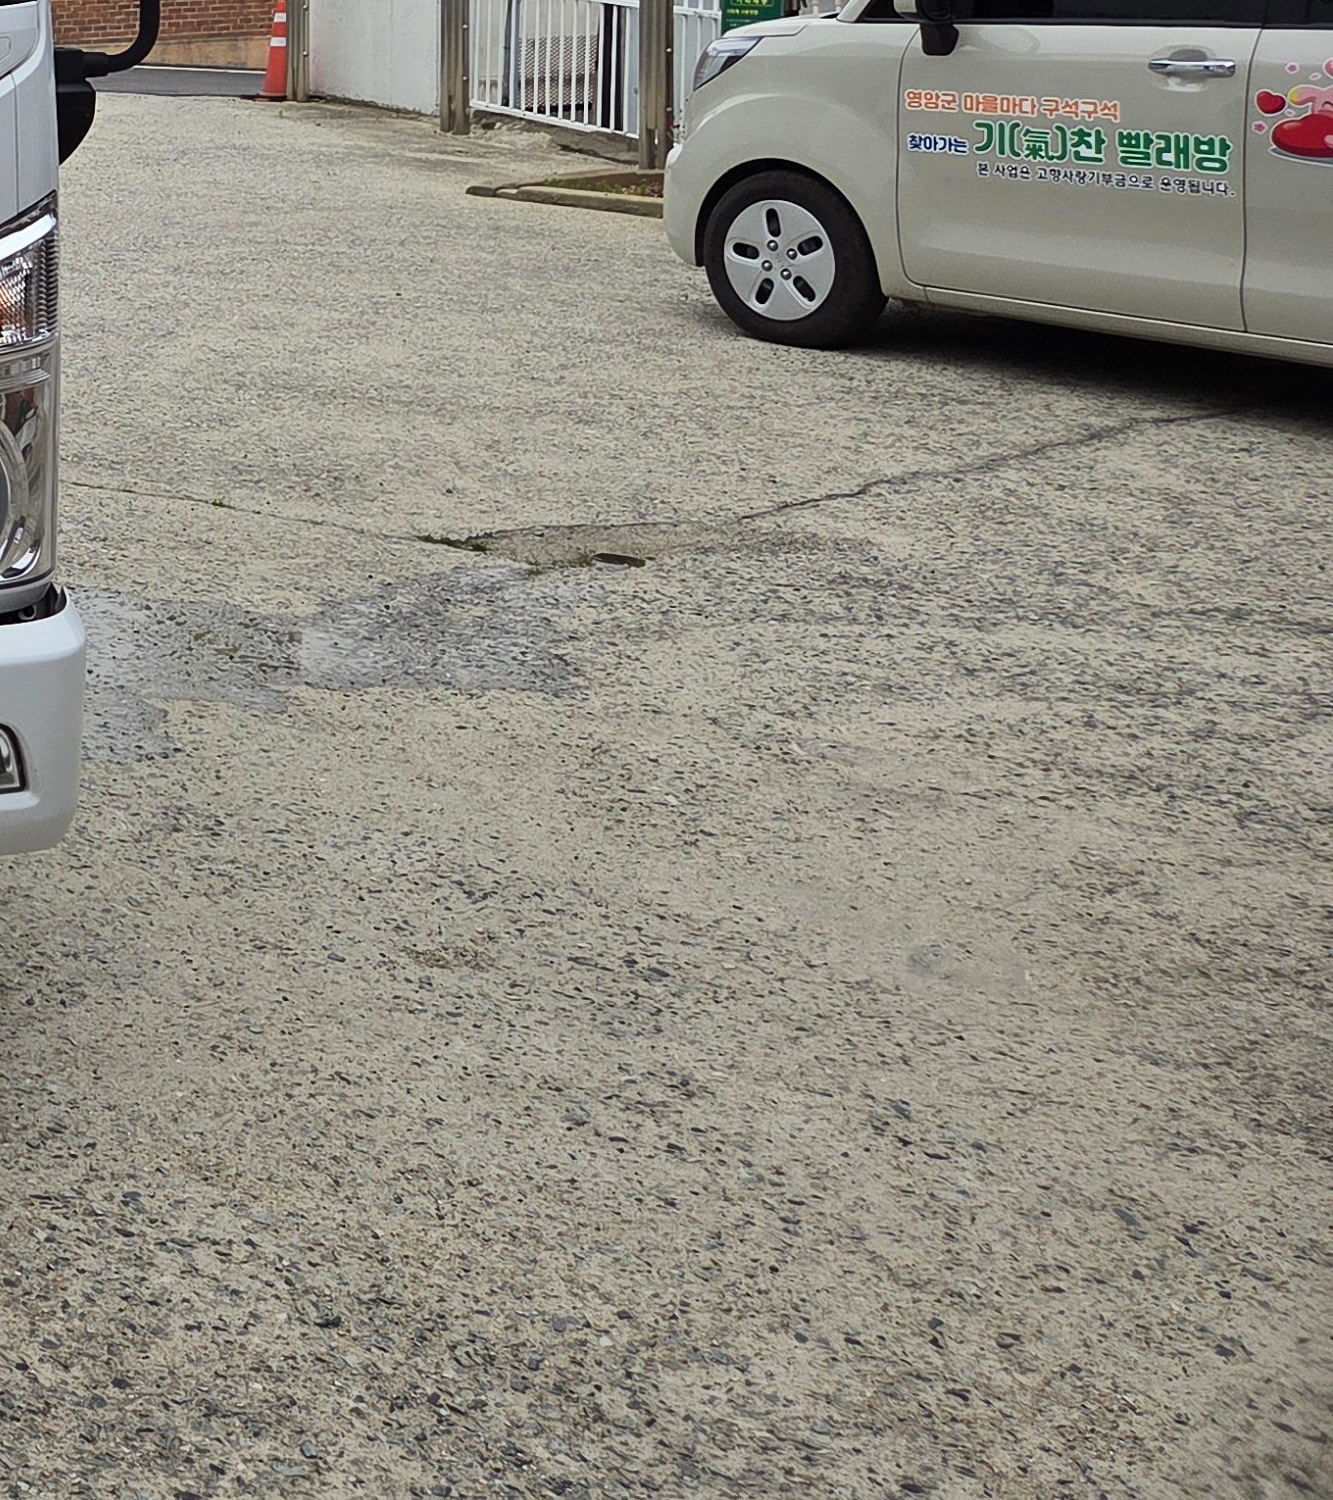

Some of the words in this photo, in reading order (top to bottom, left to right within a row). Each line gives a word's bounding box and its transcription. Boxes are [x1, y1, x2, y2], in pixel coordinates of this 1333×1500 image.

[905, 90, 958, 111] 영암군
[962, 94, 1037, 116] 마을마다
[1041, 98, 1120, 122] 구석구석
[908, 134, 968, 155] 찾아가는
[972, 121, 1106, 163] 기(氣)찬
[1117, 130, 1231, 173] 빨래방
[977, 163, 990, 177] 본
[994, 164, 1032, 180] 사업은
[1036, 167, 1155, 190] 고향사랑기부금으로
[1159, 176, 1236, 196] 운영됩니다.
